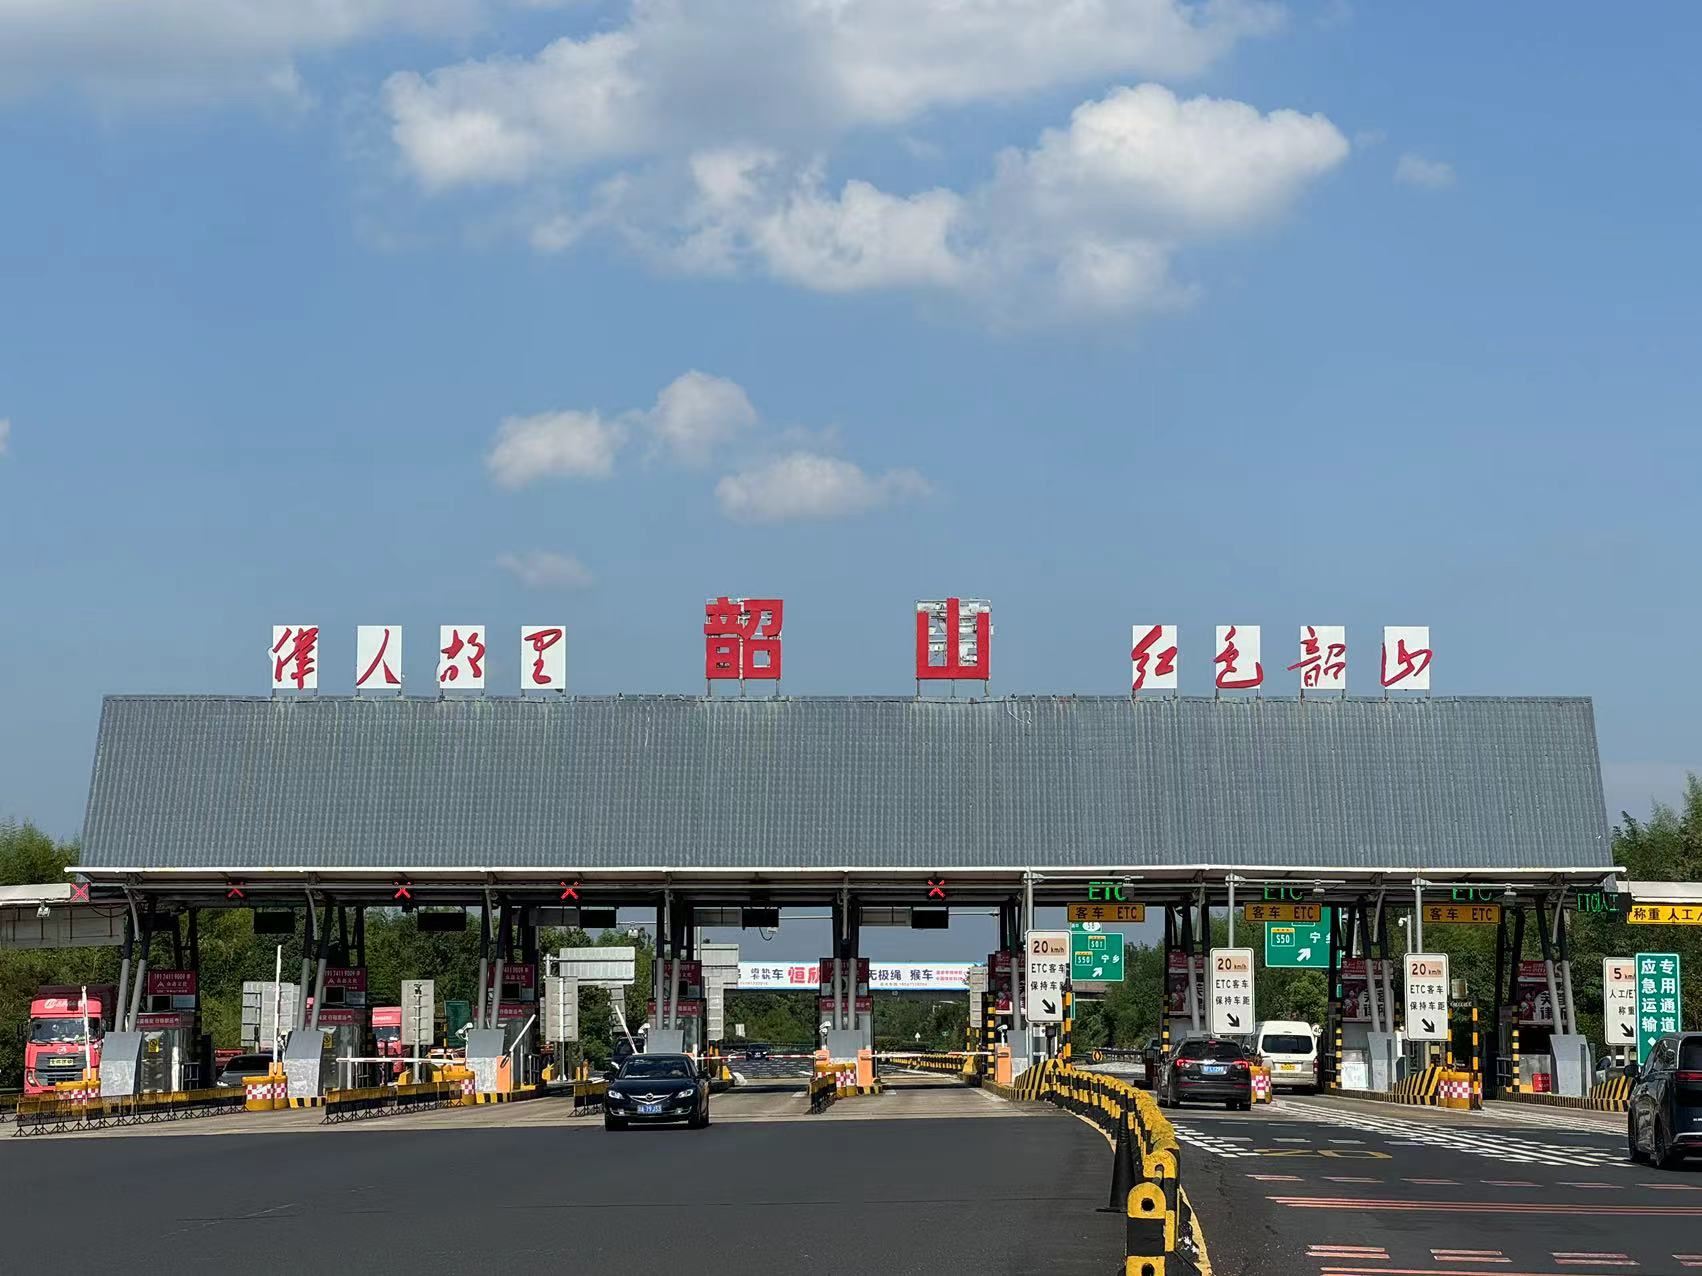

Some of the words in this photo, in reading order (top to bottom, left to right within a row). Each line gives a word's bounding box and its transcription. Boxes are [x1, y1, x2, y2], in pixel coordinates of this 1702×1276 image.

[1088, 881, 1127, 901] ETC
[1076, 907, 1104, 920] 客车
[1117, 906, 1138, 920] ETC
[1252, 906, 1281, 919] 客车
[1294, 906, 1314, 919] ETC
[1430, 908, 1458, 921] 客车
[1472, 908, 1492, 921] ETC
[1634, 907, 1661, 921] 称重
[1276, 934, 1290, 944] S50
[1033, 940, 1048, 953] 20
[1077, 956, 1091, 964] S50
[1101, 954, 1120, 963] 宁乡
[1217, 957, 1232, 970] 20
[1411, 963, 1427, 975] 20
[1613, 967, 1622, 980] 5
[1215, 979, 1249, 989] ETC客车
[1410, 985, 1444, 995] ETC客车
[1215, 996, 1250, 1005] 保持车距
[1641, 958, 1657, 1033] 应急运输
[1659, 958, 1676, 1033] 专用通道
[1410, 1001, 1446, 1011] 保持车距
